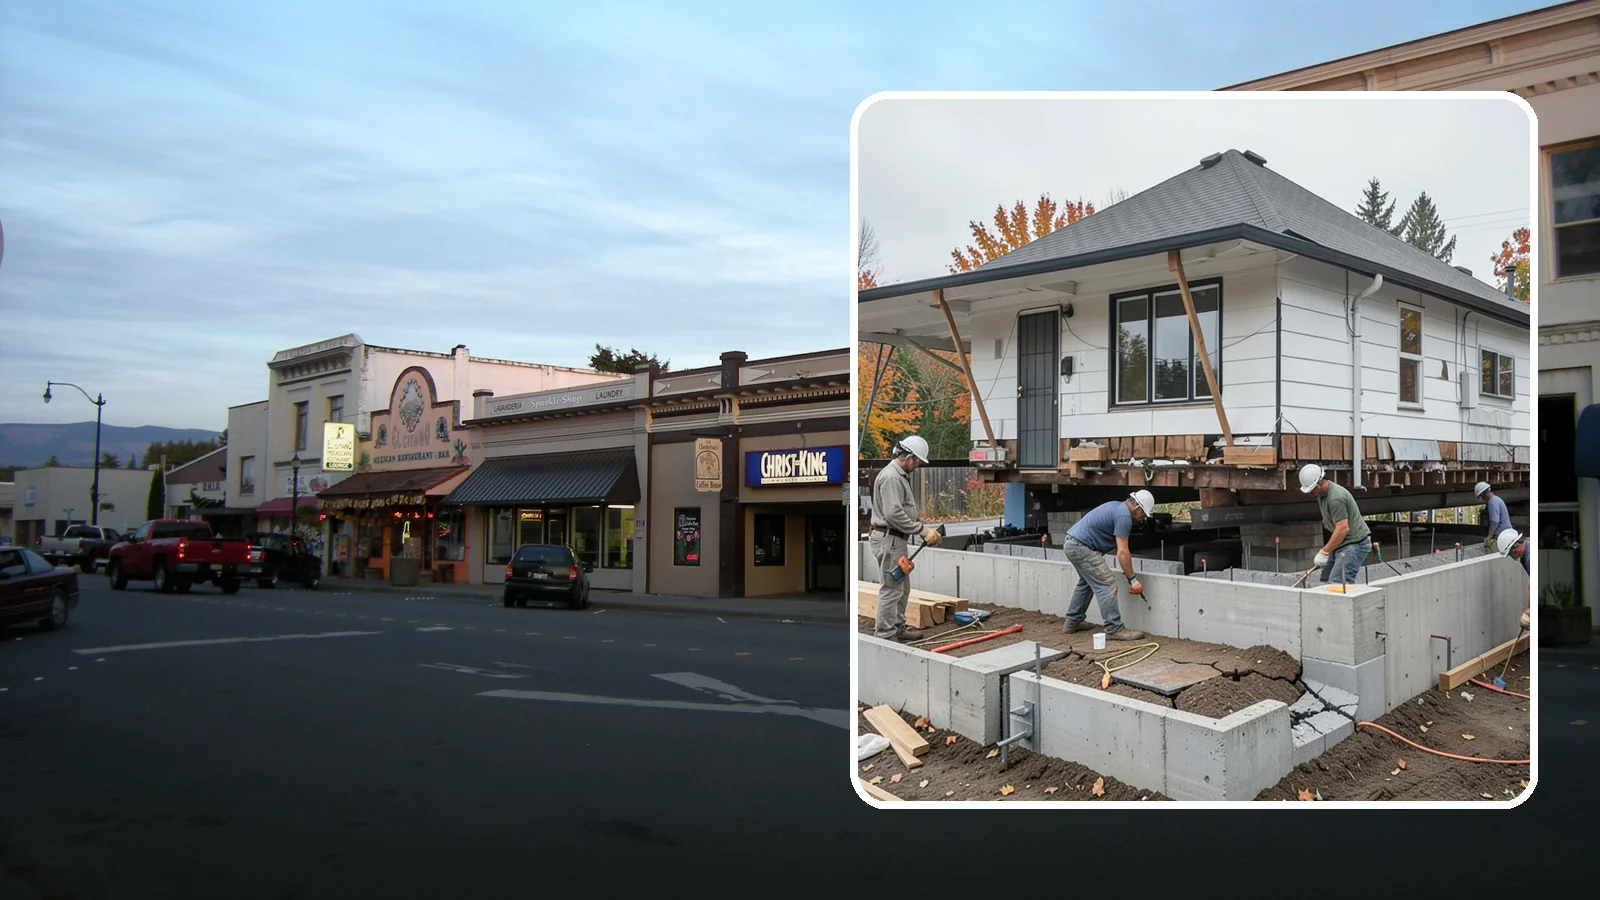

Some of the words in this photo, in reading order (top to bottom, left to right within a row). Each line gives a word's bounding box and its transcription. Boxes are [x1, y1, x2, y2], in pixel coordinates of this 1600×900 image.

[562, 394, 583, 405] Shop
[595, 389, 624, 400] LAUNDRY
[494, 402, 522, 412] LAVANDERIA
[392, 426, 402, 449] EL
[374, 455, 396, 464] MEXICAN
[397, 451, 433, 462] RESTAURANT
[438, 450, 450, 458] BAR
[761, 452, 797, 478] CHRIST
[799, 450, 827, 477] KING
